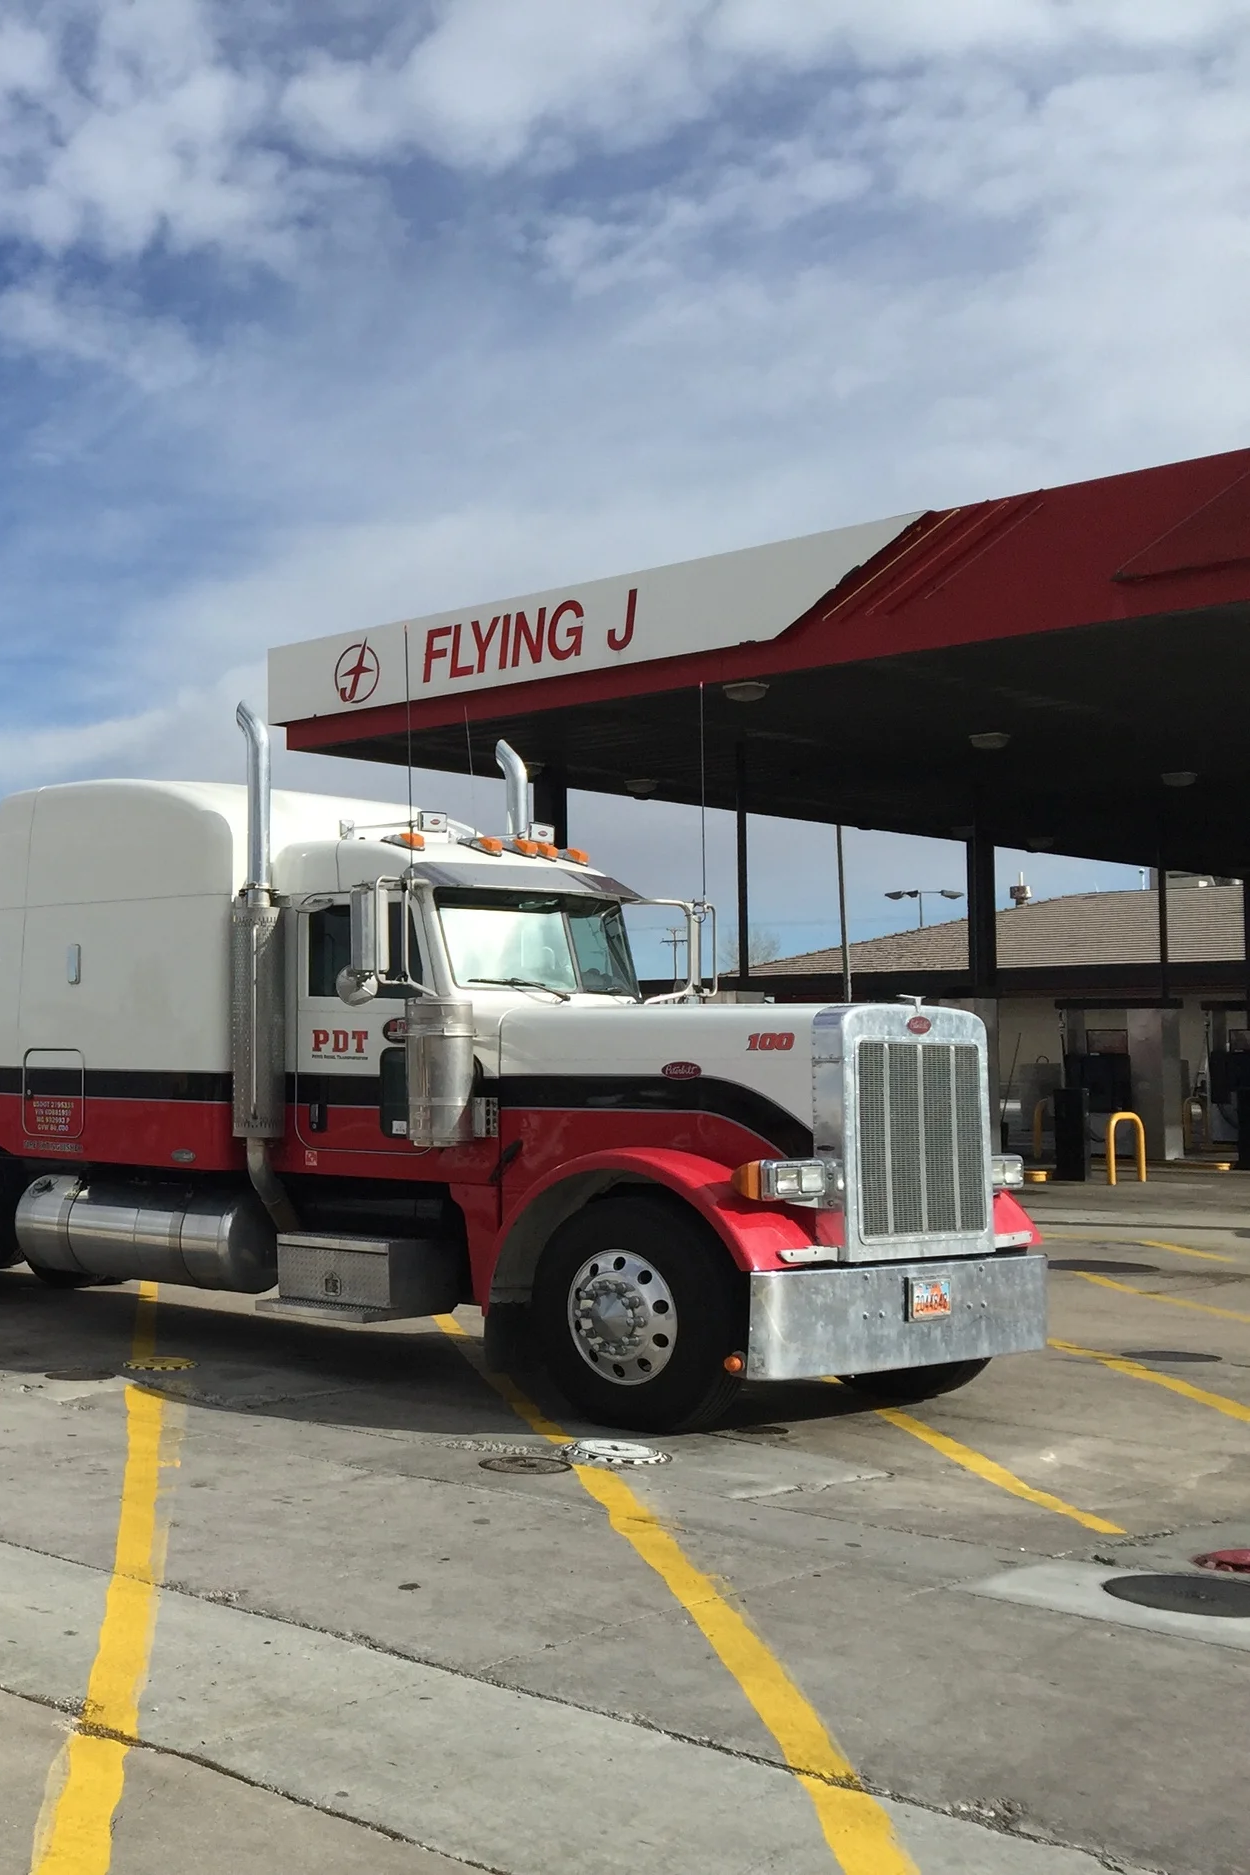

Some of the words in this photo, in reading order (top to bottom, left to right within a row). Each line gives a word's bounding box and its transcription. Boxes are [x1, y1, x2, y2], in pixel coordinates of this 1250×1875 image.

[422, 599, 584, 684] FLYING
[607, 588, 638, 652] J
[311, 1029, 369, 1054] PDT
[746, 1032, 795, 1051] 100
